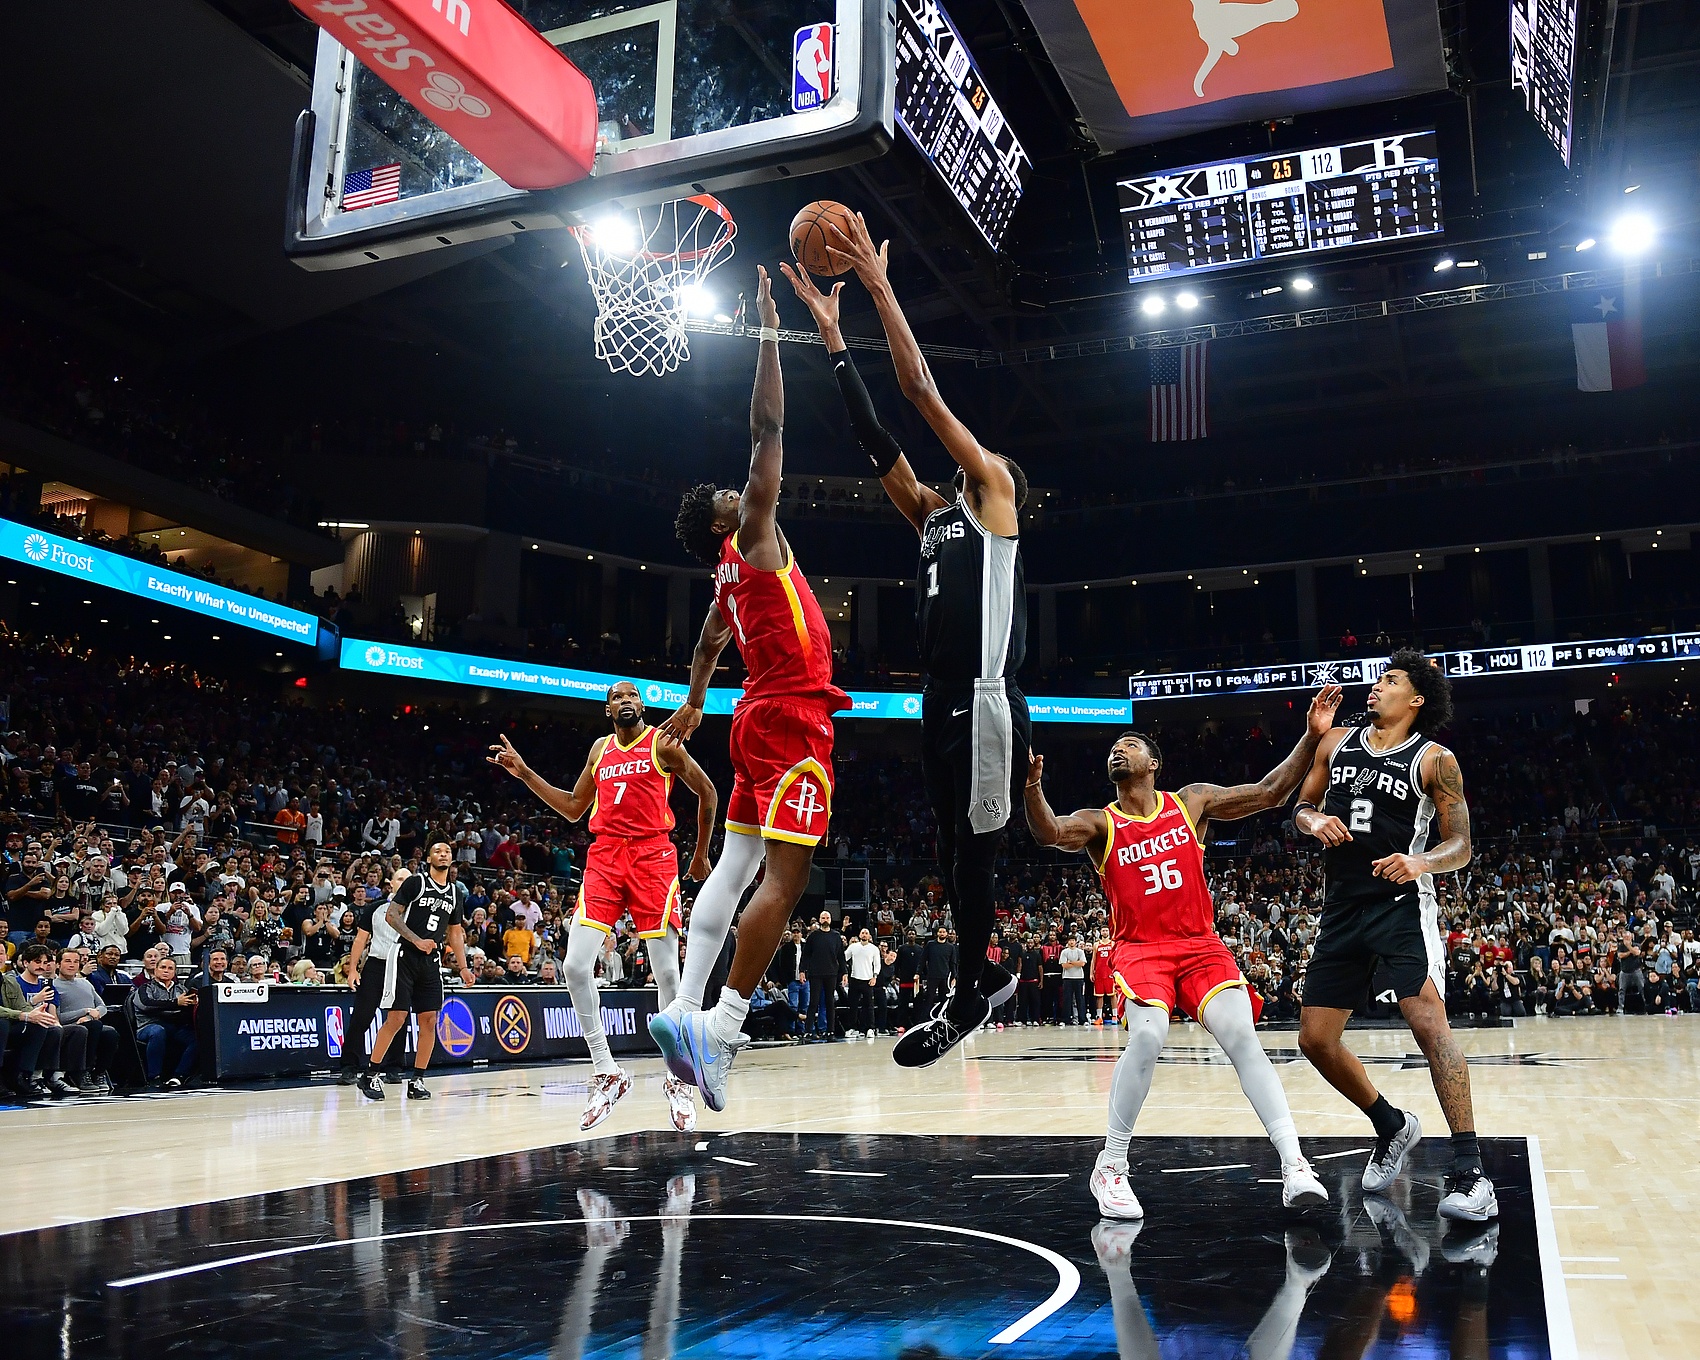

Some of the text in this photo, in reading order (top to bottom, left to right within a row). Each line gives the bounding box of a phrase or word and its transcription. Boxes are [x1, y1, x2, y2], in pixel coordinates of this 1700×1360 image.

[951, 50, 964, 78] 110
[798, 91, 816, 107] NBA
[988, 109, 1000, 135] 112
[1217, 169, 1237, 190] 110
[1272, 160, 1291, 179] 2.5
[1312, 153, 1332, 174] 112
[1285, 186, 1300, 194] BONUS
[50, 543, 94, 572] Frost
[147, 577, 192, 602] Exactly
[194, 591, 224, 610] What
[226, 599, 247, 618] You
[927, 562, 939, 598] 1
[1490, 653, 1517, 668] HOU
[1527, 650, 1546, 667] 112
[1556, 650, 1572, 661] PF
[1588, 647, 1616, 658] FG%
[1637, 644, 1655, 654] TO
[1661, 641, 1668, 653] 2
[387, 651, 424, 670] Frost
[469, 665, 509, 682] Exactly
[511, 670, 538, 684] What
[540, 674, 559, 686] You
[1196, 679, 1211, 687] TO
[1227, 676, 1251, 685] FG%
[1253, 673, 1269, 684] 48.5
[1272, 673, 1286, 682] PF
[1291, 671, 1297, 681] 5
[1342, 666, 1361, 679] SA
[663, 689, 687, 703] Fros
[1165, 685, 1172, 694] 10
[1180, 684, 1184, 693] 3
[1029, 705, 1050, 715] What
[1053, 706, 1070, 715] You
[600, 760, 650, 781] ROCKETS
[613, 782, 627, 804] 7
[1331, 766, 1409, 800] SPURS
[1349, 798, 1374, 833] 2
[1117, 825, 1190, 867] ROCKETS
[1138, 859, 1183, 896] 36
[419, 897, 455, 914] SPURS
[426, 914, 440, 932] 5
[224, 986, 232, 997] G
[257, 986, 264, 996] G
[238, 1018, 316, 1035] AMERICAN
[480, 1016, 490, 1035] VS
[544, 1007, 585, 1039] MOND
[624, 1008, 636, 1035] ET
[251, 1034, 318, 1051] EXPRESS
